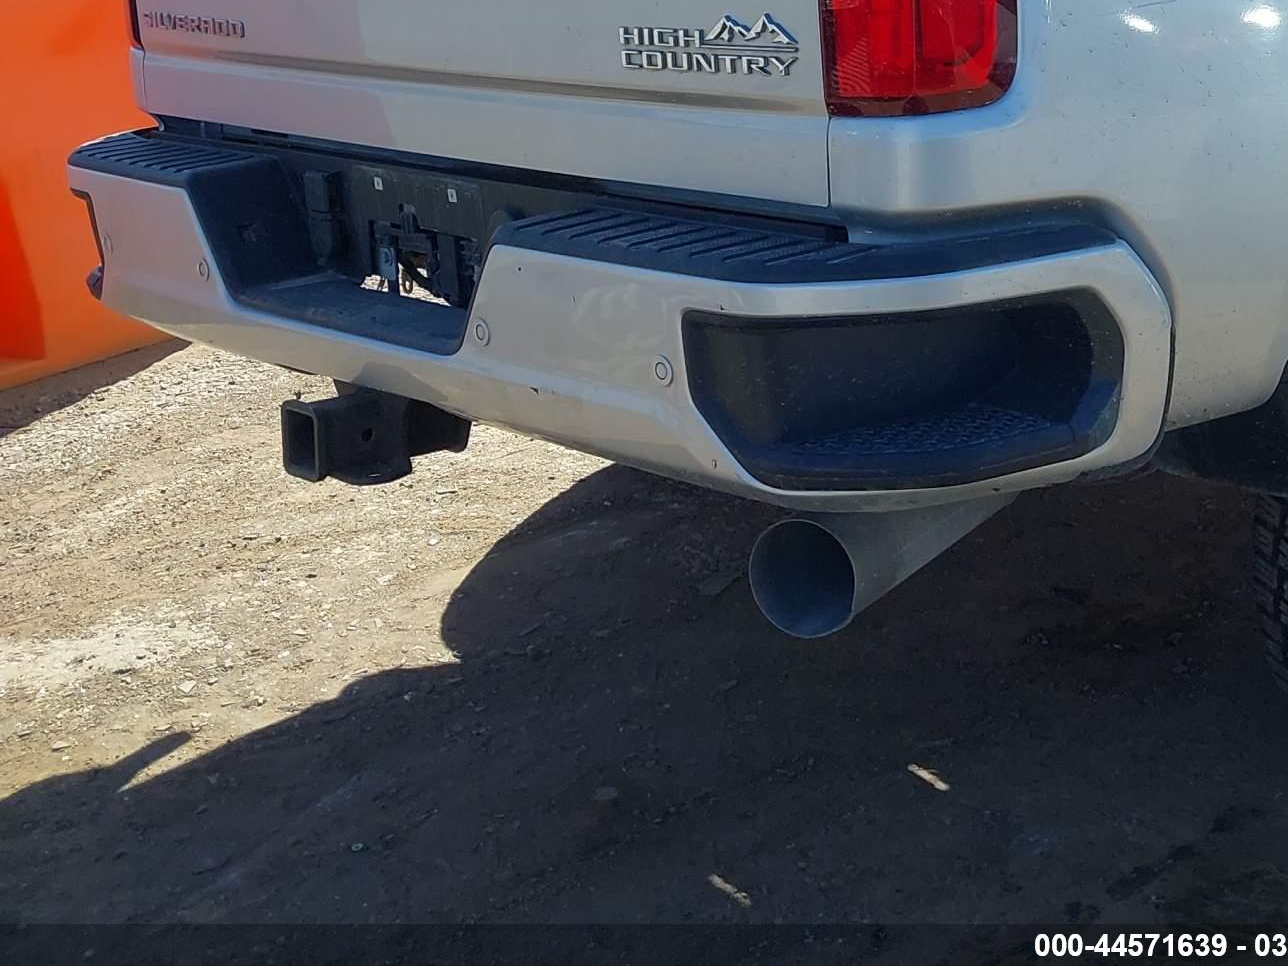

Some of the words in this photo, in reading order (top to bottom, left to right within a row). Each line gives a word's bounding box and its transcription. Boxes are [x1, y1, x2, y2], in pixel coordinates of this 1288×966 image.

[144, 10, 246, 39] SILVERADO
[618, 26, 704, 48] HIGH
[620, 48, 799, 77] COUNTRY
